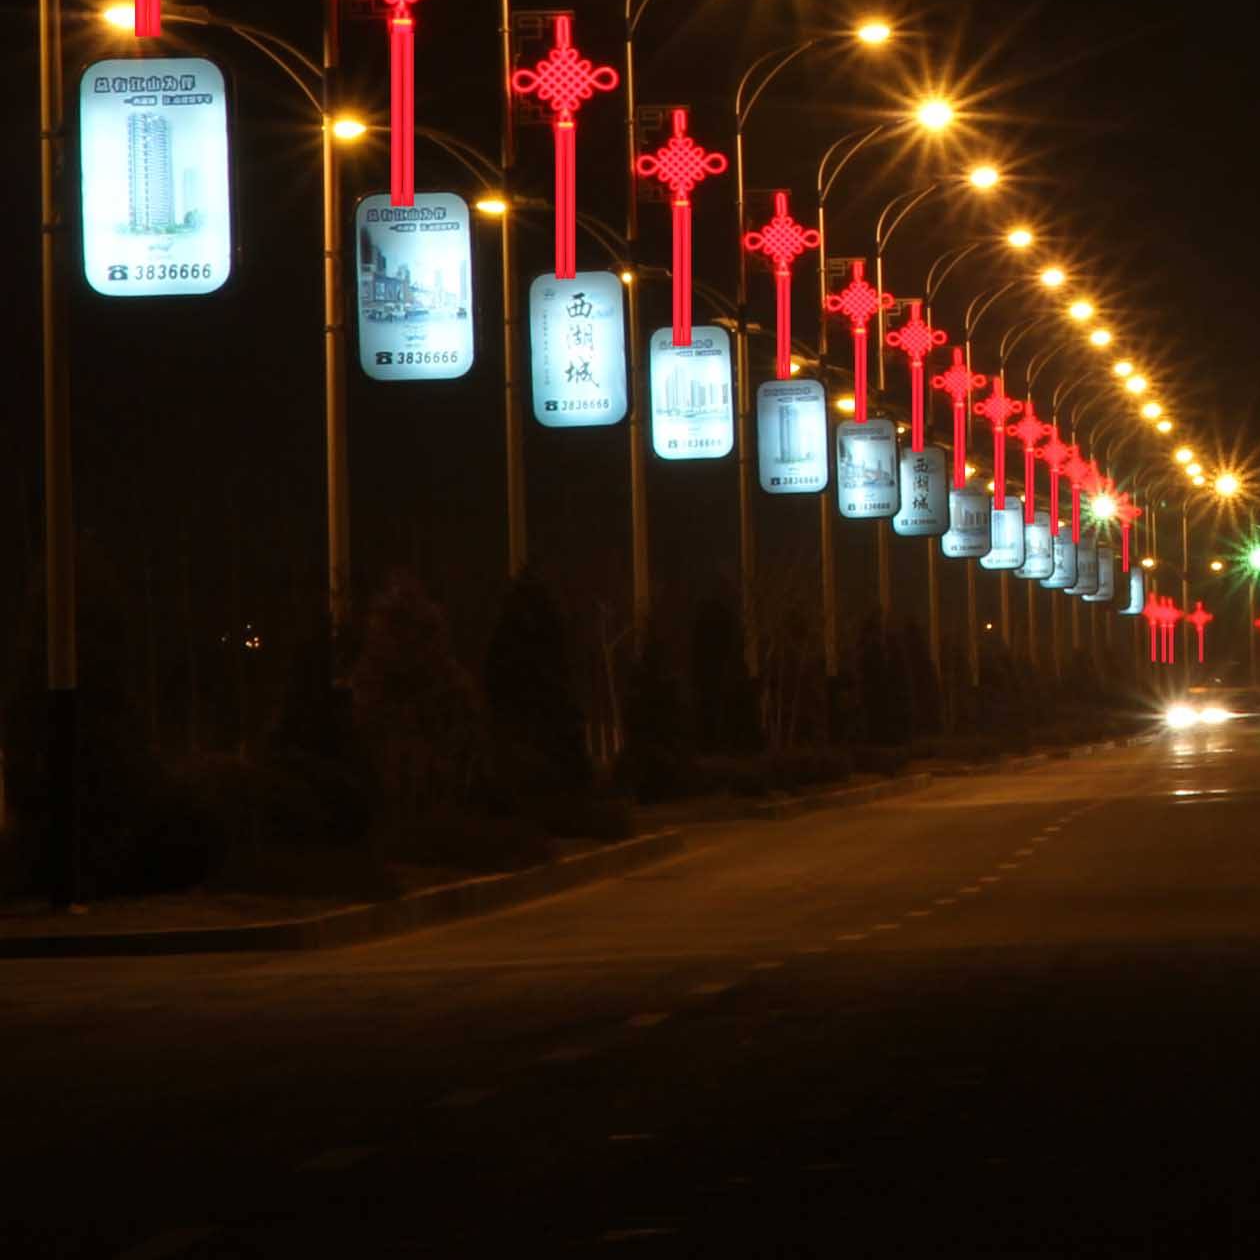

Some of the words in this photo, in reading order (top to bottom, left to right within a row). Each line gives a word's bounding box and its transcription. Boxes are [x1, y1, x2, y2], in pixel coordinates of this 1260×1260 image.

[135, 263, 212, 281] 3836666
[564, 292, 600, 388] 西湖城
[397, 351, 459, 365] 3836666
